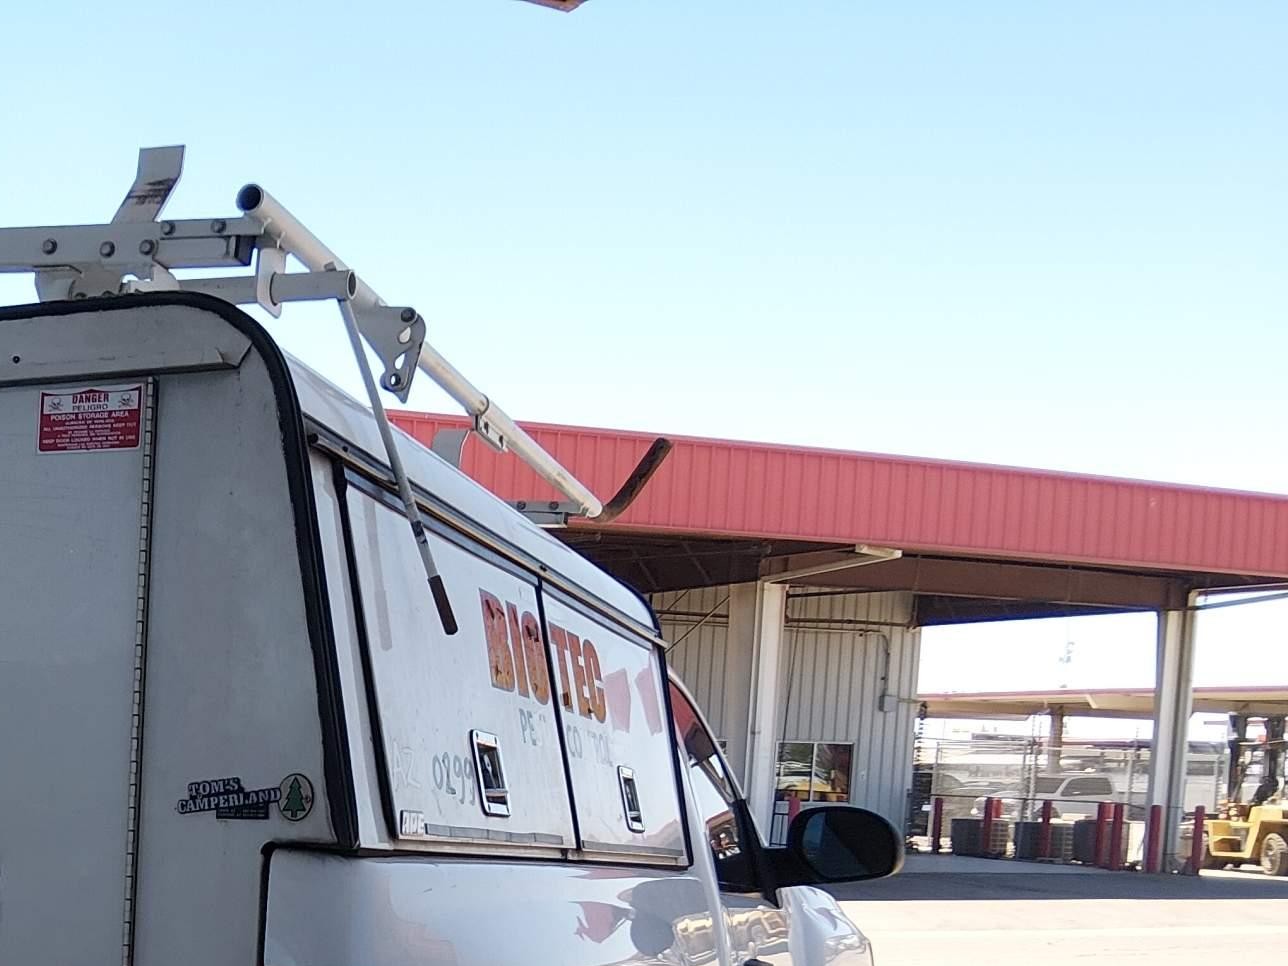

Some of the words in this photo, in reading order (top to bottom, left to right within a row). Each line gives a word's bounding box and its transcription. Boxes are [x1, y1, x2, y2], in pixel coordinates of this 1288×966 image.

[72, 392, 109, 404] DANGER
[78, 412, 109, 420] STORAGE
[188, 778, 240, 797] TOM'S
[178, 788, 281, 813] CAMPERLAND
